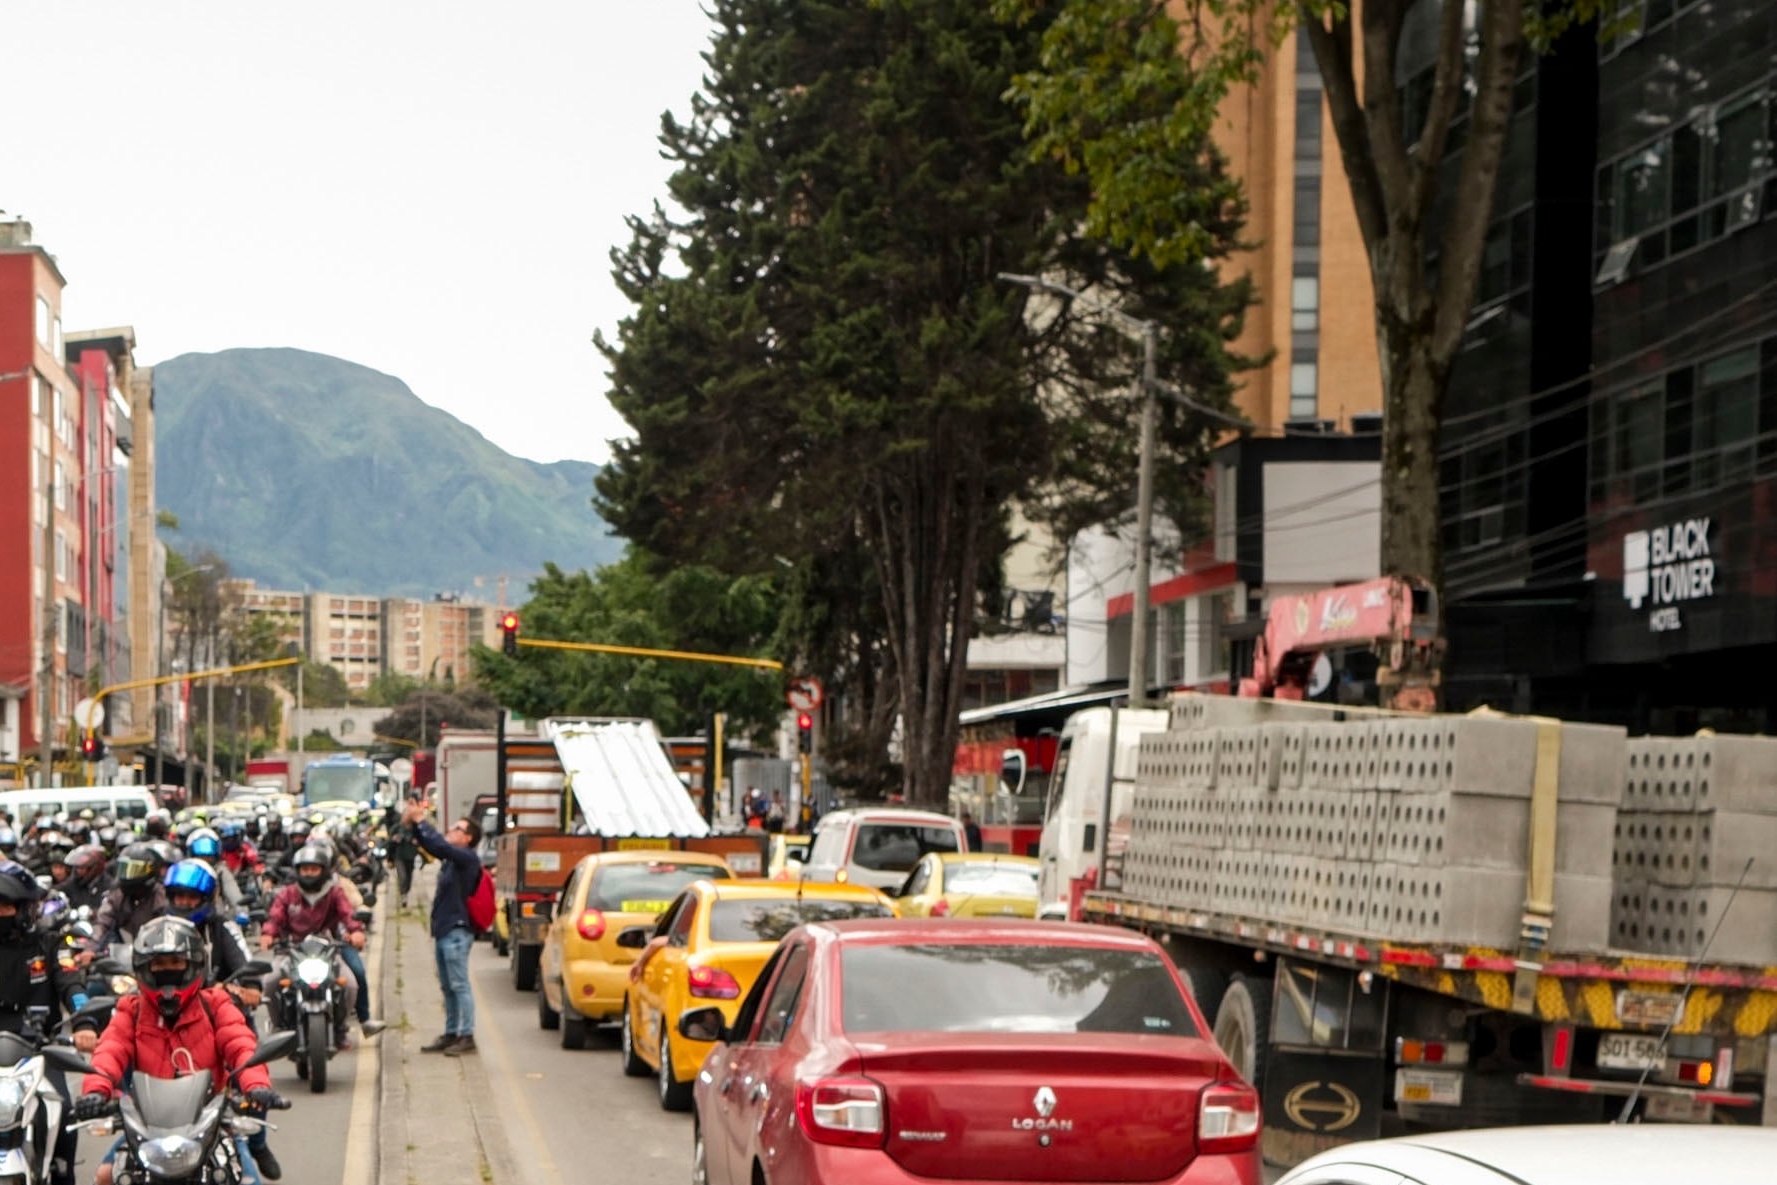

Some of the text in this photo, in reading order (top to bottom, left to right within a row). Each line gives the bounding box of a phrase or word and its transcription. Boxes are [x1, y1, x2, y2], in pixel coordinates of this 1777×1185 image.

[1651, 516, 1711, 566] BLACK
[1650, 557, 1715, 605] TOWER
[1649, 606, 1682, 633] HOTEL
[1012, 1117, 1073, 1131] LOGAN
